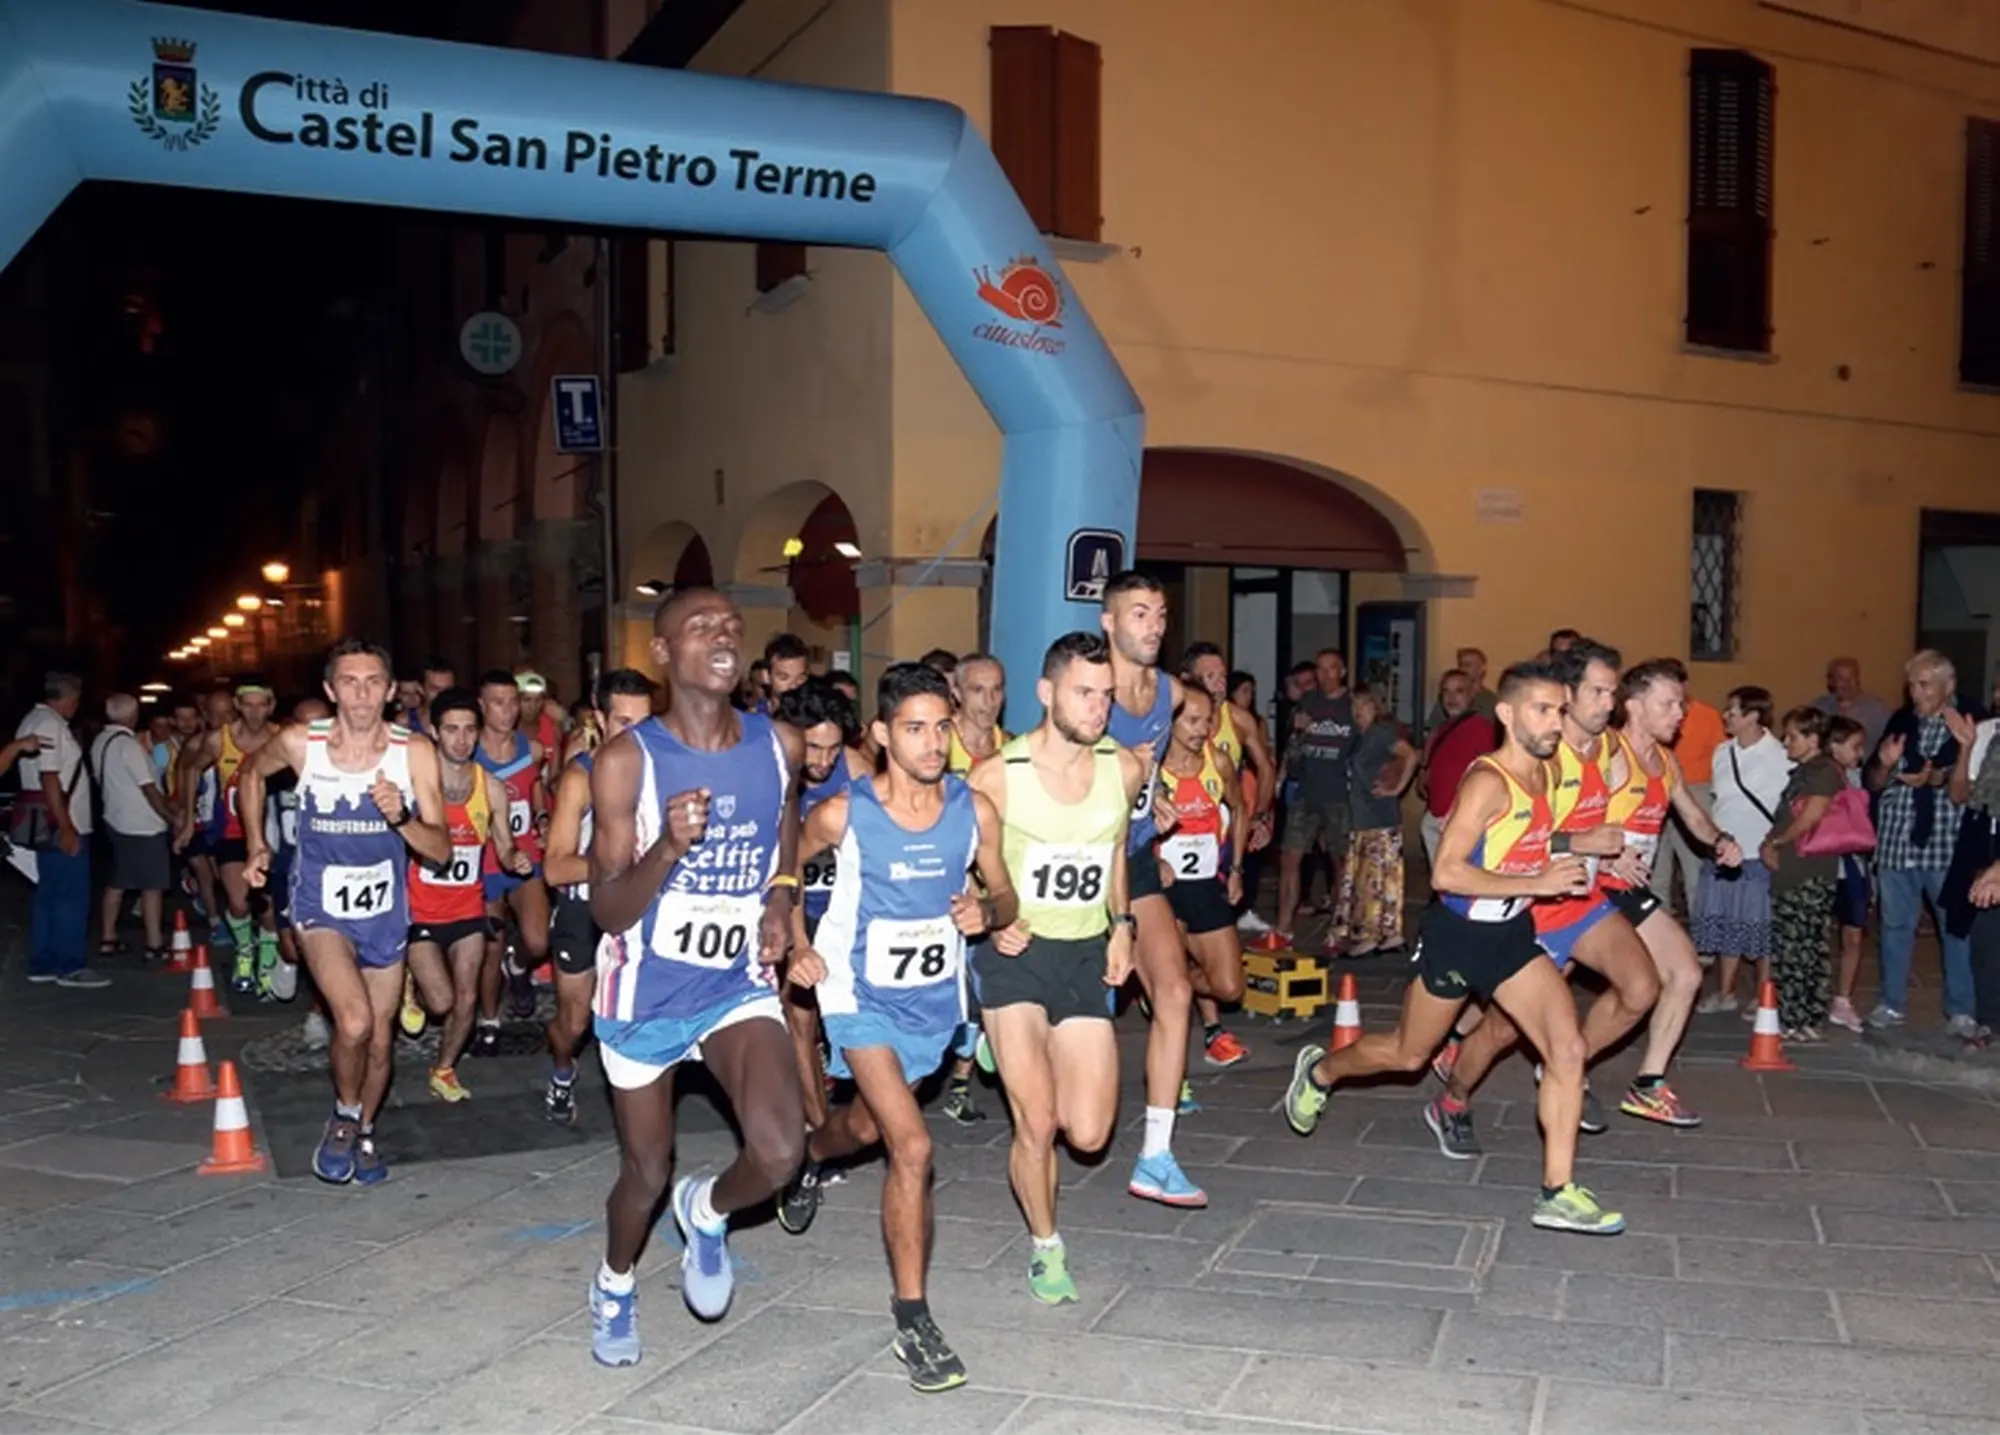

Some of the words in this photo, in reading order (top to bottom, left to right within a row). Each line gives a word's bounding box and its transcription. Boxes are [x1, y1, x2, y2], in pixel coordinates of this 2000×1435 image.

[359, 82, 389, 110] di
[449, 118, 548, 171] San
[563, 131, 717, 188] Pietro
[729, 148, 876, 203] Terme
[679, 841, 765, 869] Celtic
[1182, 852, 1200, 875] 2
[669, 866, 761, 893] Druid
[1032, 863, 1104, 902] 198
[335, 880, 390, 913] 147
[674, 921, 747, 960] 100
[888, 943, 946, 981] 78
